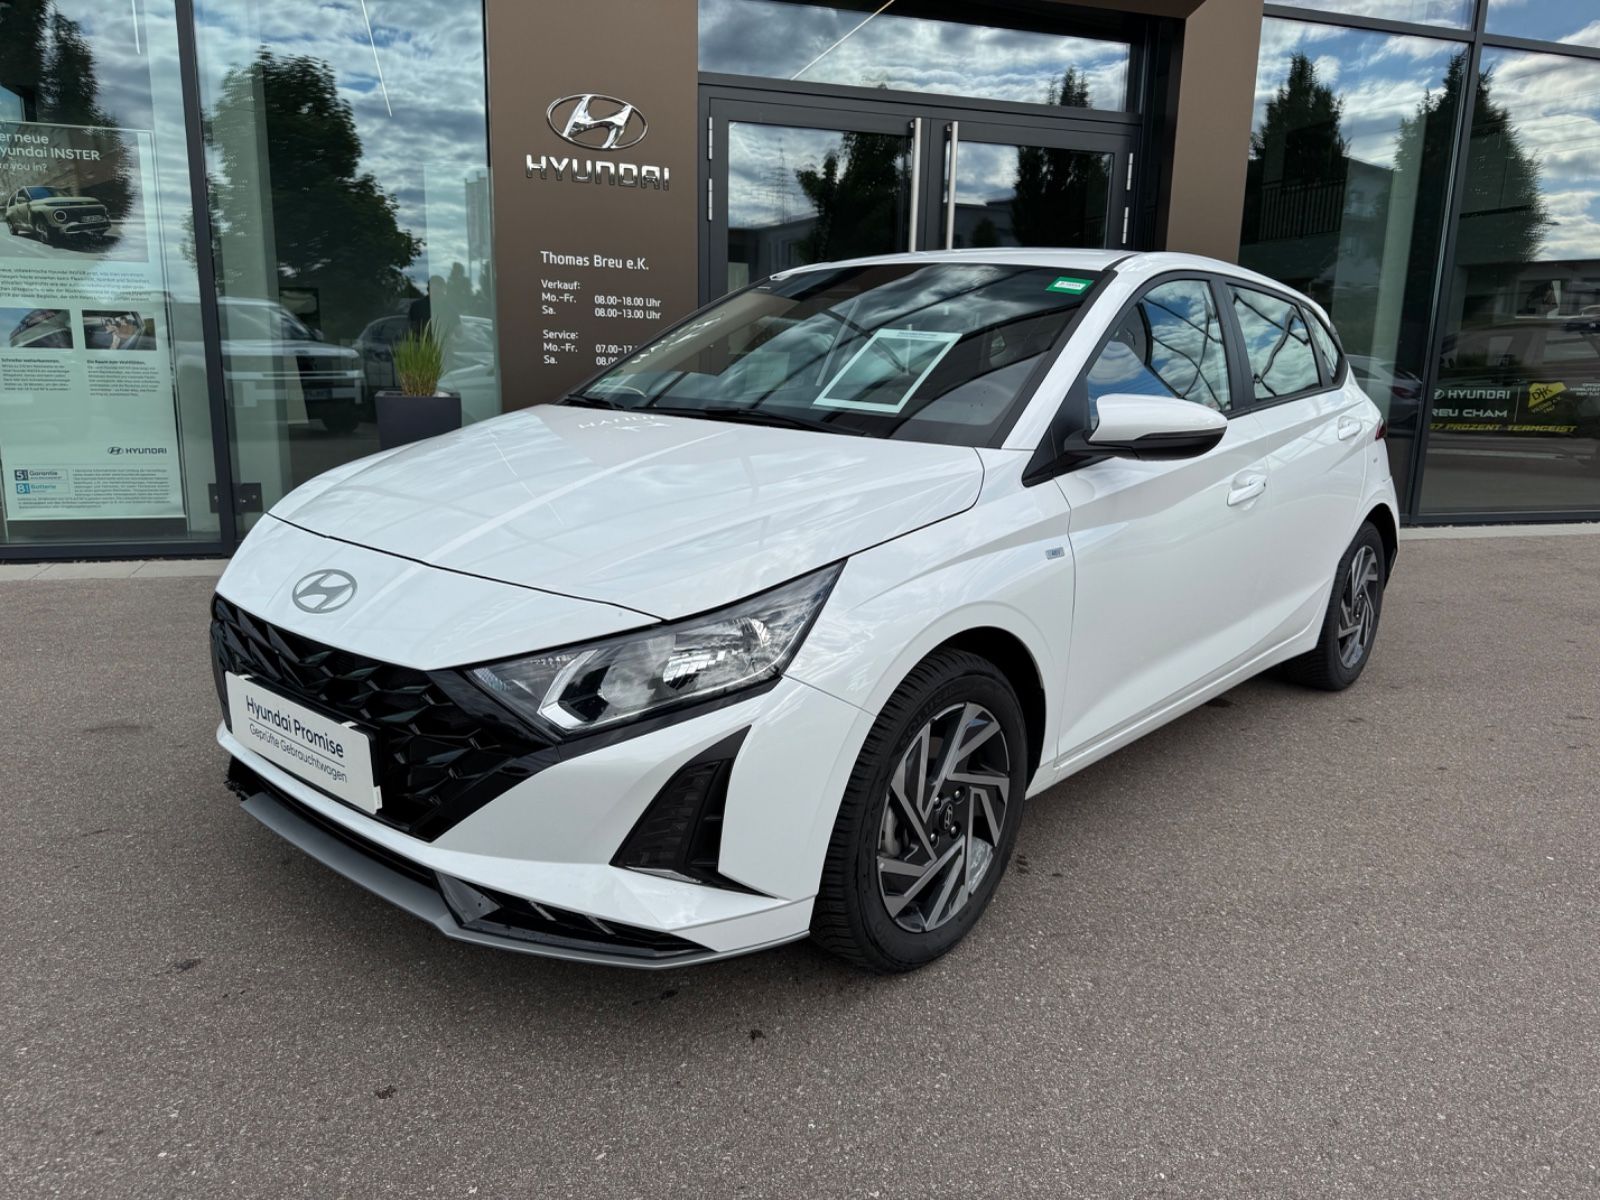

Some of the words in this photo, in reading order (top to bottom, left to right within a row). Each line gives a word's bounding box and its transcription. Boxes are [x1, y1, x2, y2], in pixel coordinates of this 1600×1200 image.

[14, 133, 49, 144] neue
[51, 147, 101, 161] INSTER
[526, 154, 670, 191] HYUNDAI
[540, 250, 590, 266] Thomas
[593, 254, 623, 269] Breu
[626, 257, 650, 270] e.K.
[540, 279, 581, 290] Verkauf:
[541, 292, 577, 303] Mo.-Fr.
[594, 295, 644, 306] 08.00-18.00
[645, 298, 661, 307] Uhr
[542, 305, 556, 315] Sa.
[594, 308, 644, 319] 08.00-13.00
[645, 311, 661, 320] Uhr
[542, 329, 579, 340] Service:
[543, 342, 578, 353] Mo.-Fr.
[543, 354, 558, 364] Sa.
[1447, 389, 1510, 400] HYUNDAI
[1462, 408, 1508, 418] CHAM
[125, 447, 167, 455] HYUNDAI
[245, 694, 293, 734] Hyundai
[294, 718, 345, 759] Promise
[249, 722, 280, 750] Geprüfte
[280, 739, 348, 784] Gebrauchtwagen
